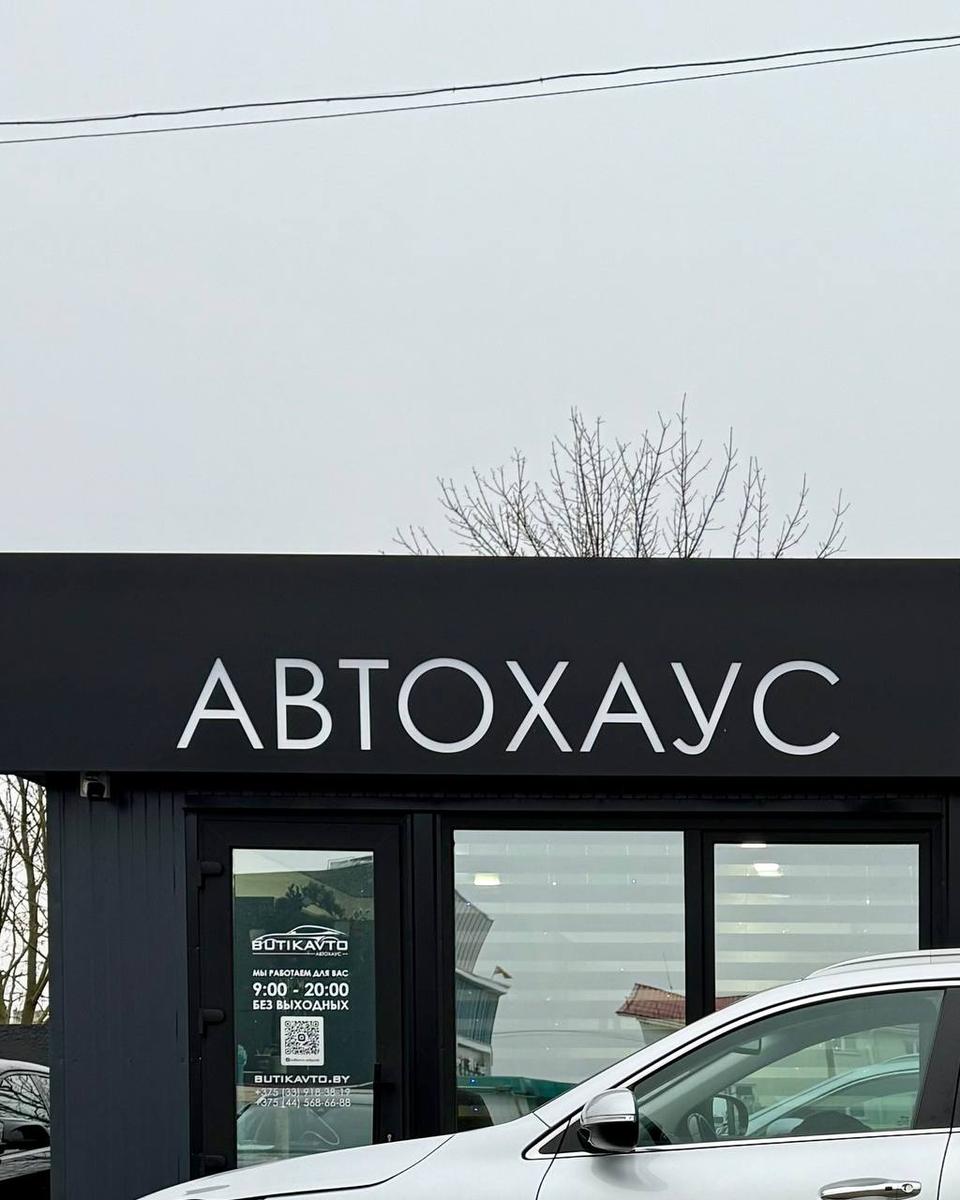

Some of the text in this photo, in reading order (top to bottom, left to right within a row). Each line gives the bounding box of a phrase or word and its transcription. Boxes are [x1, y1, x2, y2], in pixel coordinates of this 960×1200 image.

[177, 658, 840, 755] АВТОХАУС
[252, 940, 348, 951] BUTIKAVTO
[253, 969, 349, 978] МЫ РАБОТАЕМ ДЛЯ ВАС
[252, 982, 288, 997] 9:00
[304, 982, 350, 997] 20:00
[253, 1000, 349, 1011] БЕЗ ВЫХОДНЫХ
[254, 1075, 351, 1083] BUTIKAVTO.BY
